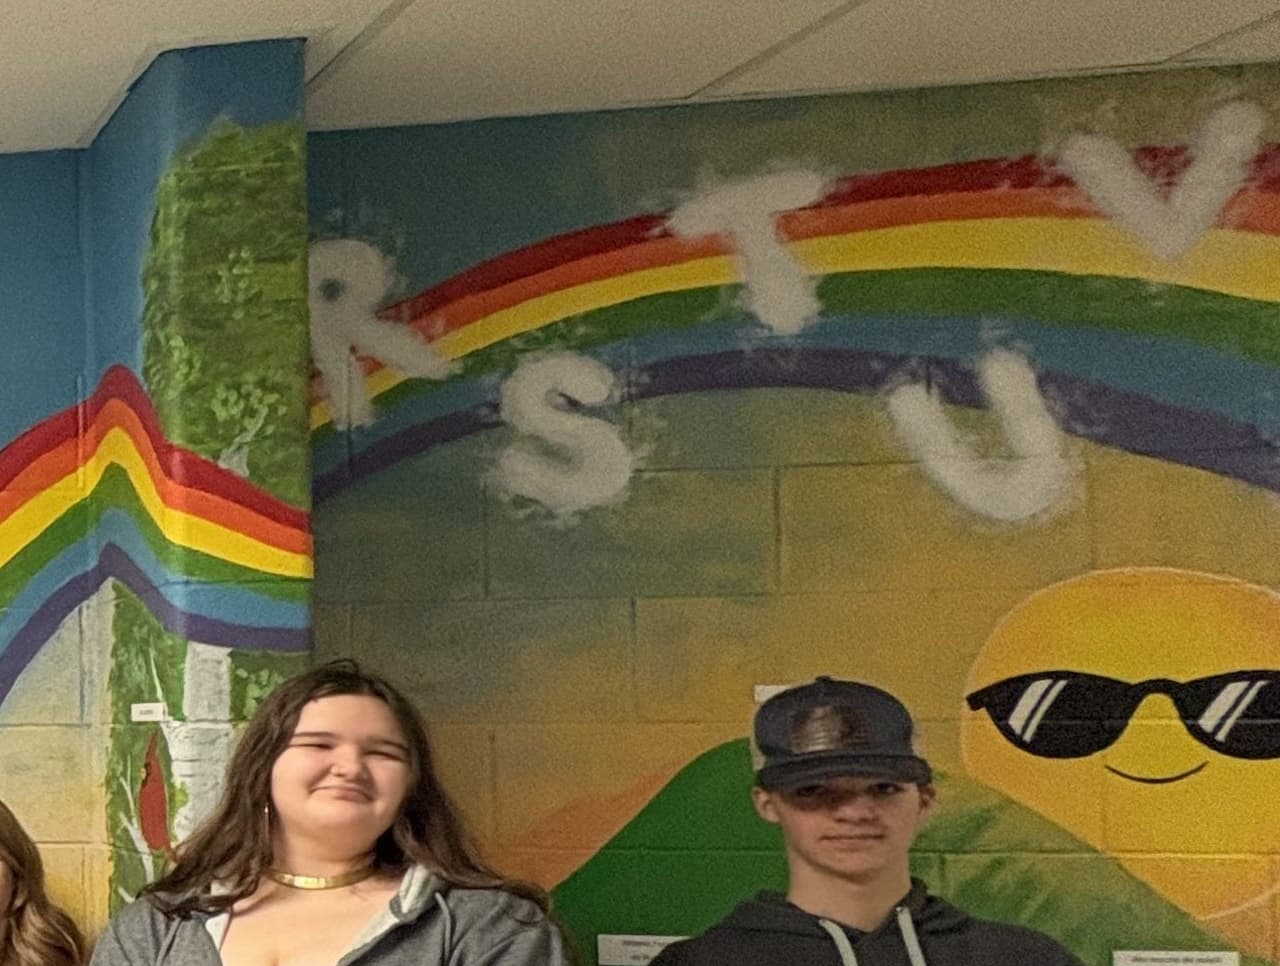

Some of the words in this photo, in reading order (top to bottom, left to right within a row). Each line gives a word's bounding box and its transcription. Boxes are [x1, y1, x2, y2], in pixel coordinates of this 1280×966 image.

[307, 238, 452, 430] R
[667, 167, 837, 336] T
[1056, 100, 1264, 262] V
[490, 350, 637, 522] S
[886, 344, 1086, 525] U
